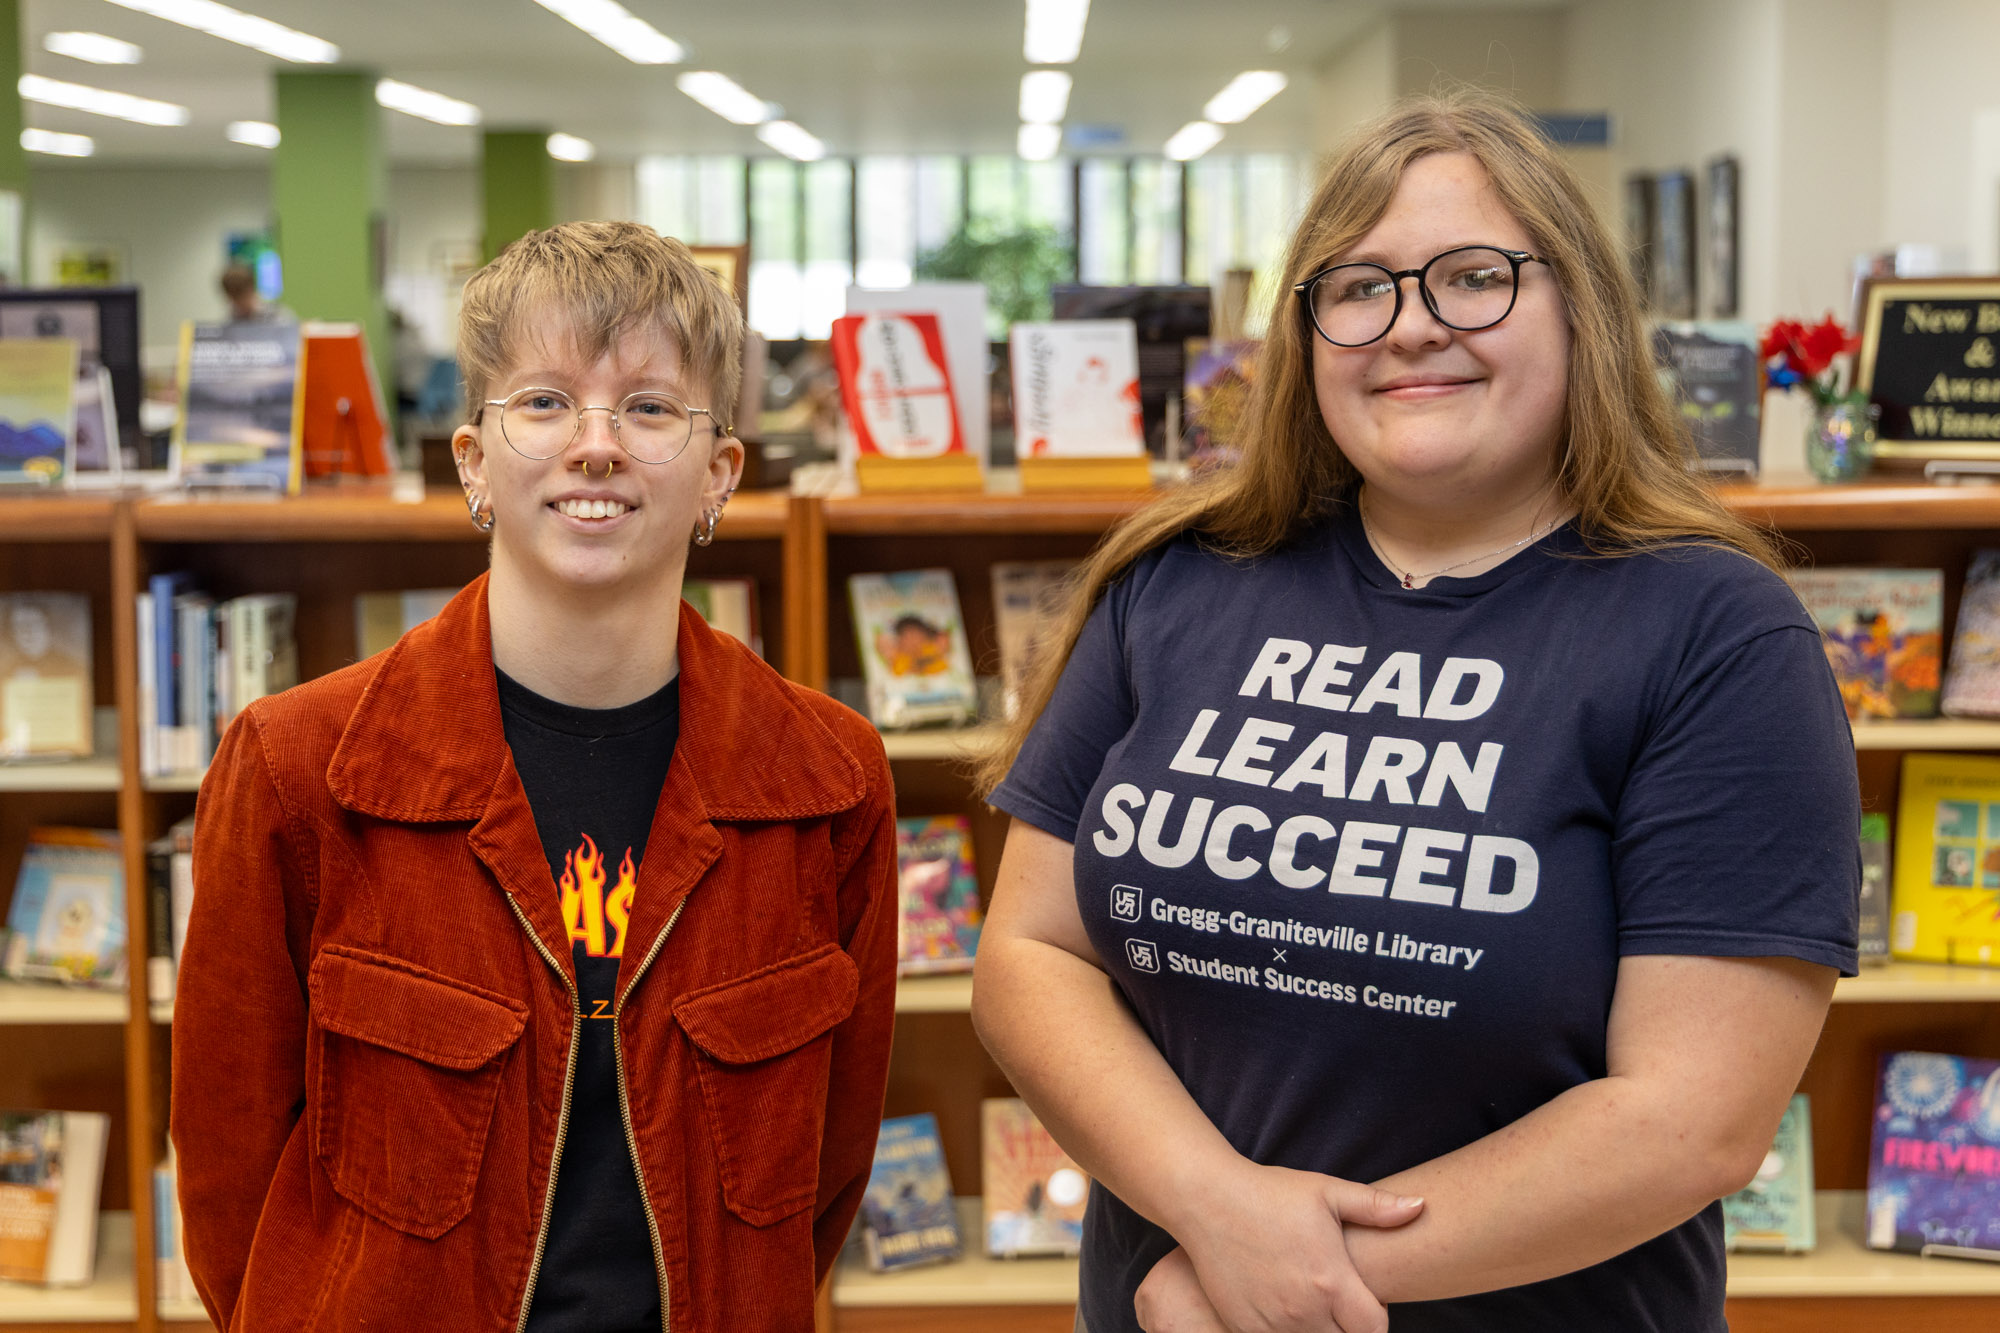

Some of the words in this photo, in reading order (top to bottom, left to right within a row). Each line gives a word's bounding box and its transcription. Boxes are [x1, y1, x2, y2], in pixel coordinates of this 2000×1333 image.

[1903, 303, 1971, 334] New
[1963, 336, 1996, 368] &
[1238, 637, 1504, 721] READ
[1169, 709, 1504, 813] LEARN
[1092, 783, 1539, 914] SUCCEED
[1151, 897, 1369, 953] Gregg-Graniteville
[1375, 931, 1484, 971] Library
[1167, 951, 1260, 987] Student
[1264, 967, 1357, 1003] Success
[1362, 985, 1457, 1018] Center
